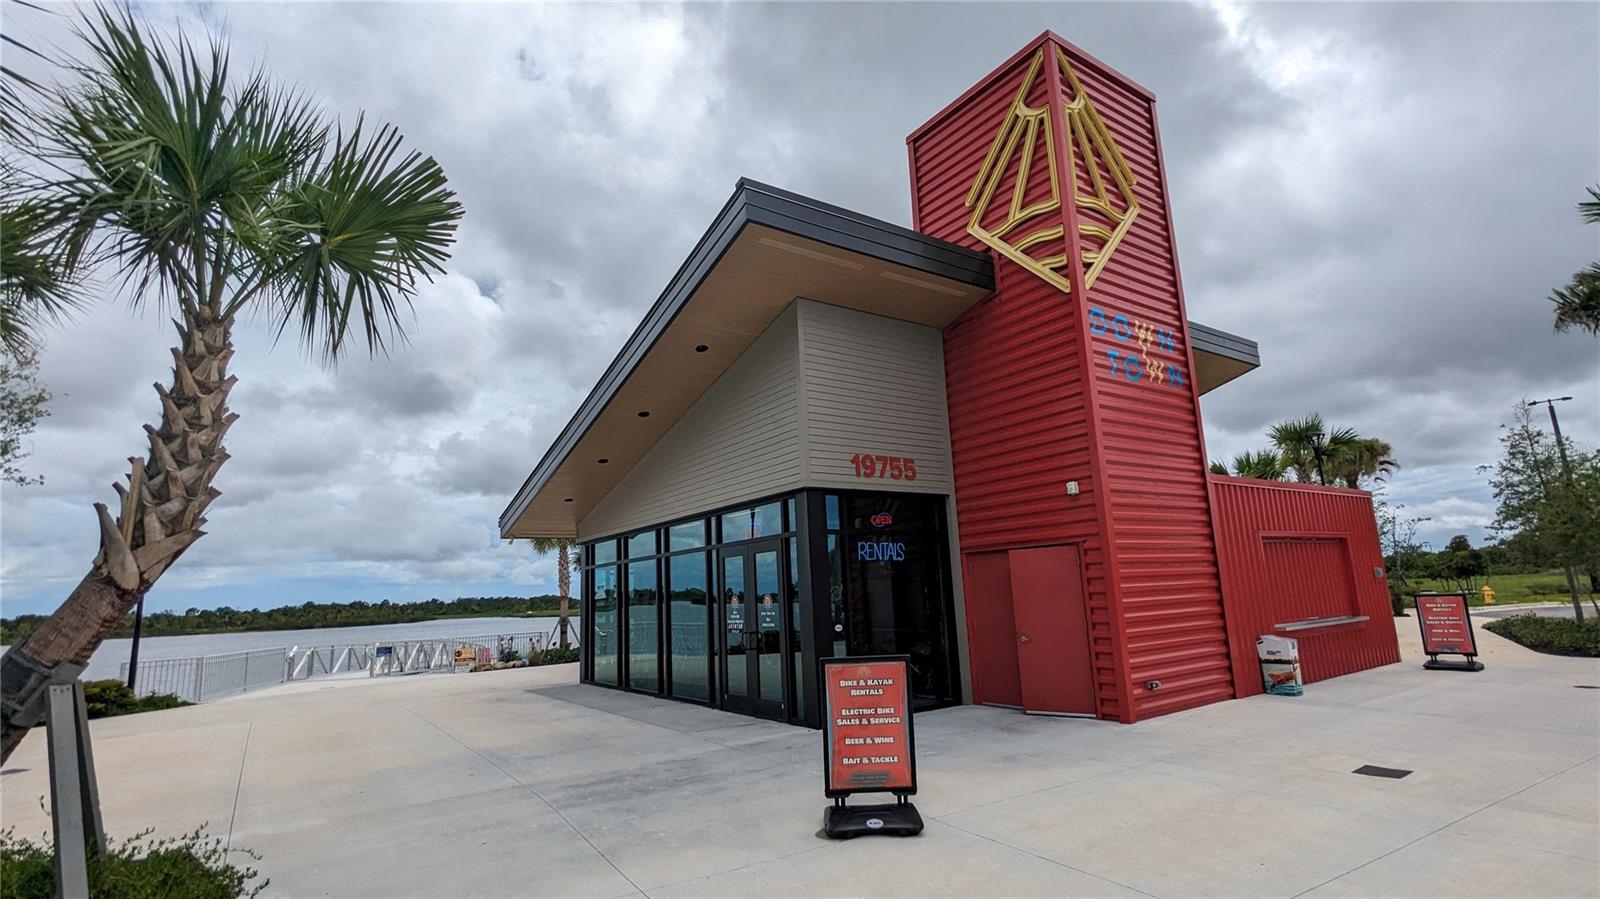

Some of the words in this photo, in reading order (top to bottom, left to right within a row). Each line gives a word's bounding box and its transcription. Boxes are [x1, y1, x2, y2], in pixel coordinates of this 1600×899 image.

[1090, 307, 1176, 353] DOWN
[1106, 348, 1184, 388] TOWN
[850, 453, 917, 481] 19755
[858, 542, 905, 561] RENTALS
[841, 708, 875, 716] ELECTRIC
[877, 707, 895, 715] BIKE
[836, 718, 860, 726] SALES
[870, 717, 901, 725] SERVICE
[843, 757, 860, 765] BAIT
[871, 756, 899, 764] TACKLE
